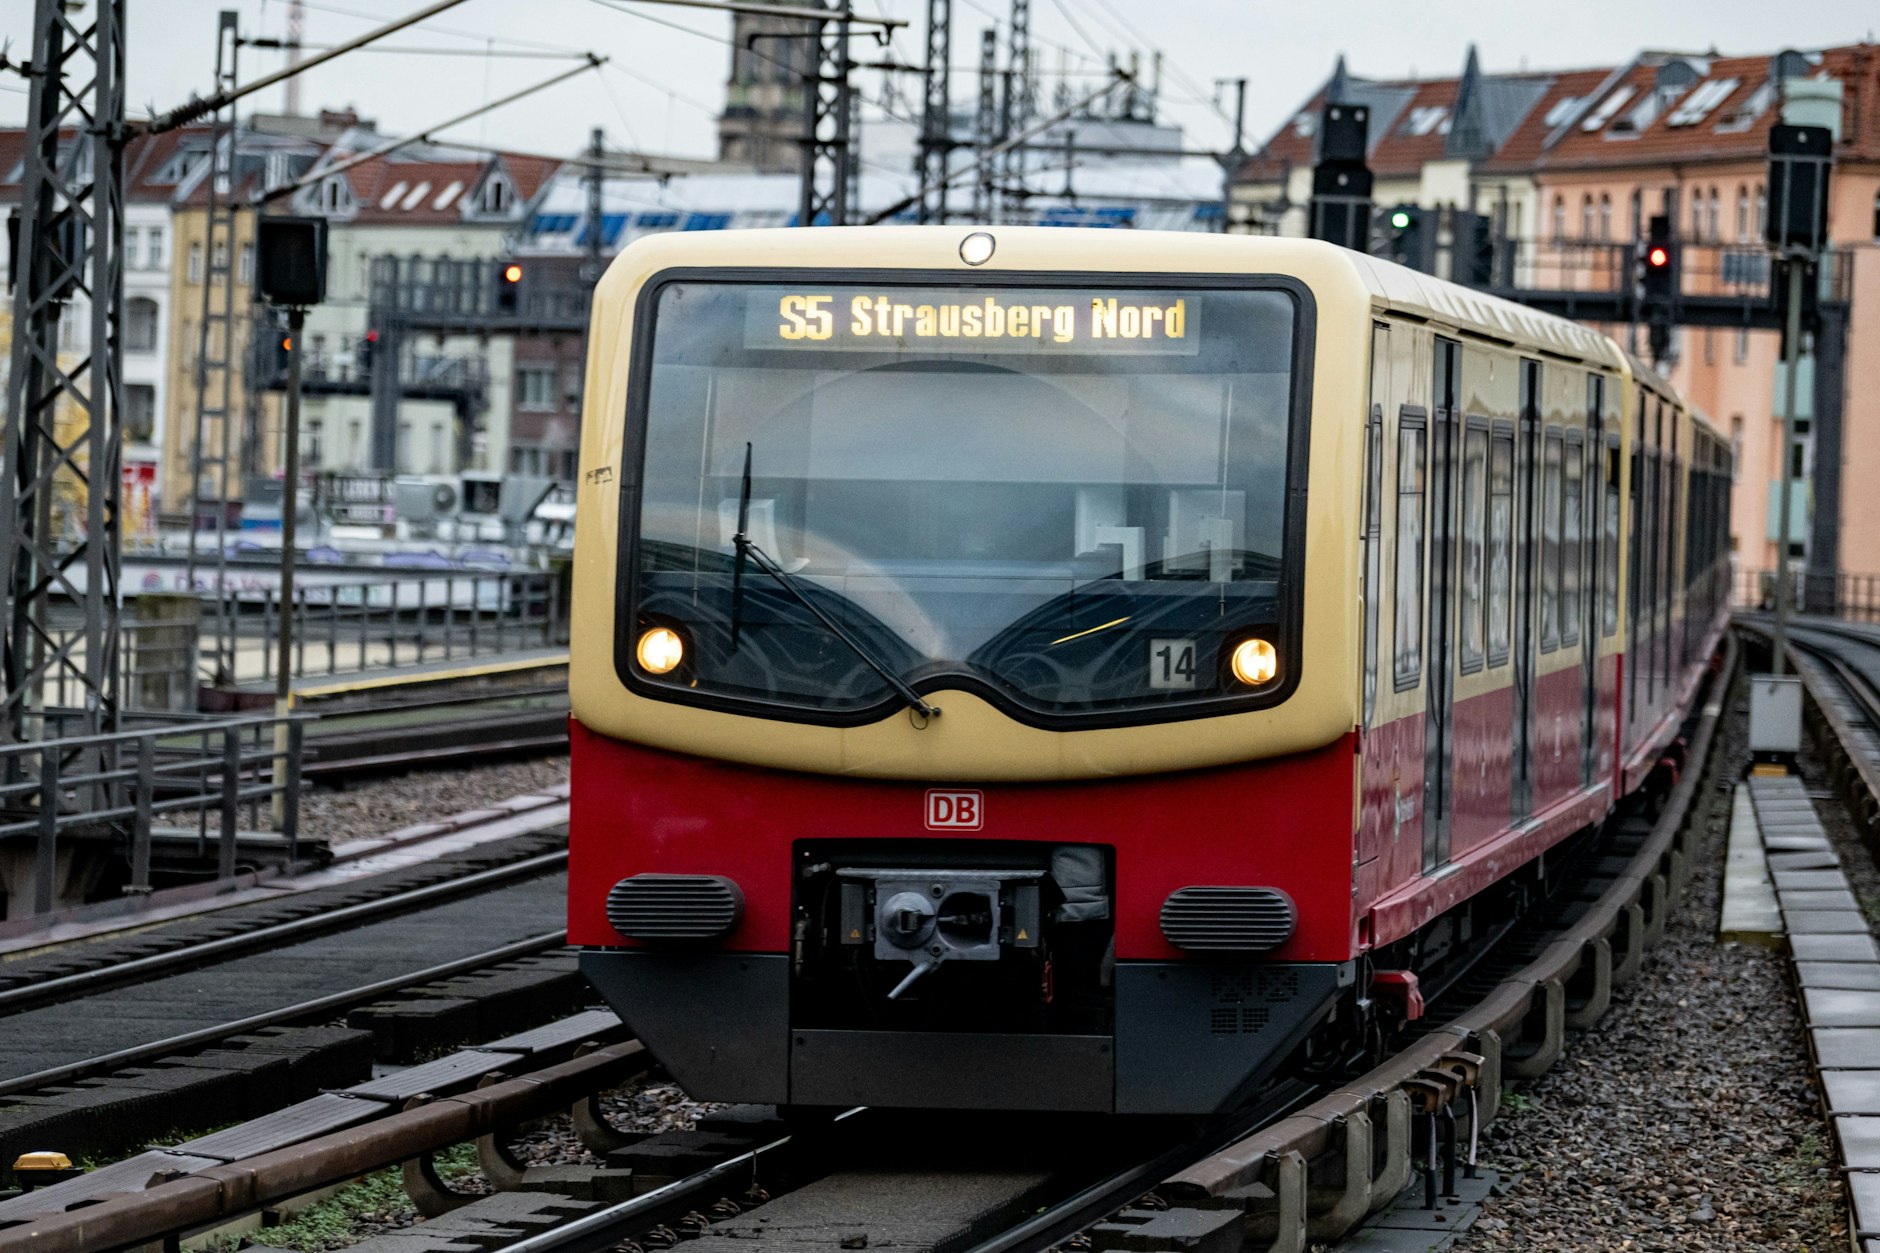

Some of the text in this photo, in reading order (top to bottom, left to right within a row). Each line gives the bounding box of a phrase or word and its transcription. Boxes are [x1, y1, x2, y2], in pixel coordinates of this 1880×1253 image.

[779, 295, 1185, 343] S5 Strausberg Nord
[1156, 645, 1197, 682] 14
[933, 796, 975, 823] DB
